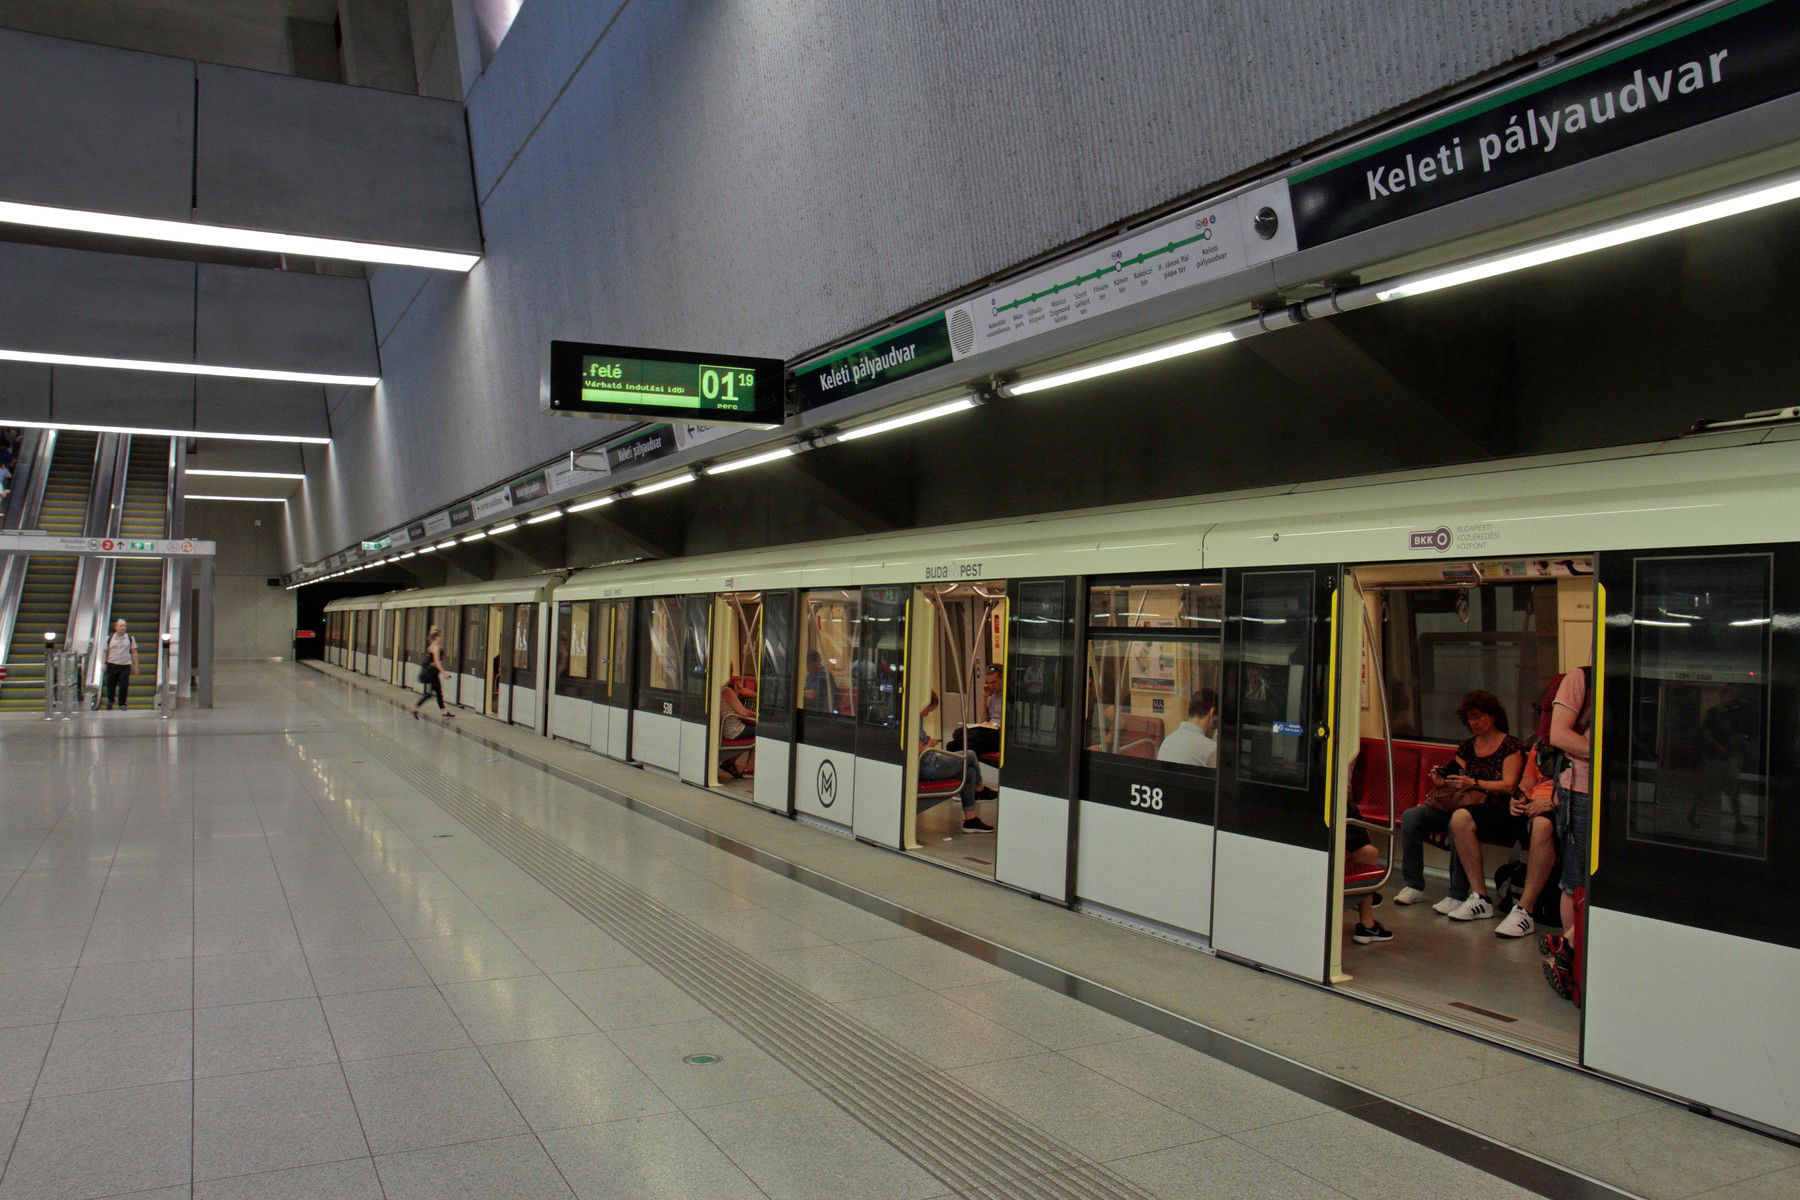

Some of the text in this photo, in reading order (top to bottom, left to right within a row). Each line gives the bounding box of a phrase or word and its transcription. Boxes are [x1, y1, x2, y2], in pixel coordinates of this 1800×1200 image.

[1366, 49, 1729, 200] Keleti pályaudvar
[819, 343, 915, 391] Keleti pályaudvar
[585, 380, 622, 390] Várható
[625, 383, 664, 393] indulási
[702, 369, 754, 401] 01 19
[1414, 535, 1434, 545] BKK
[1130, 783, 1163, 810] 538
